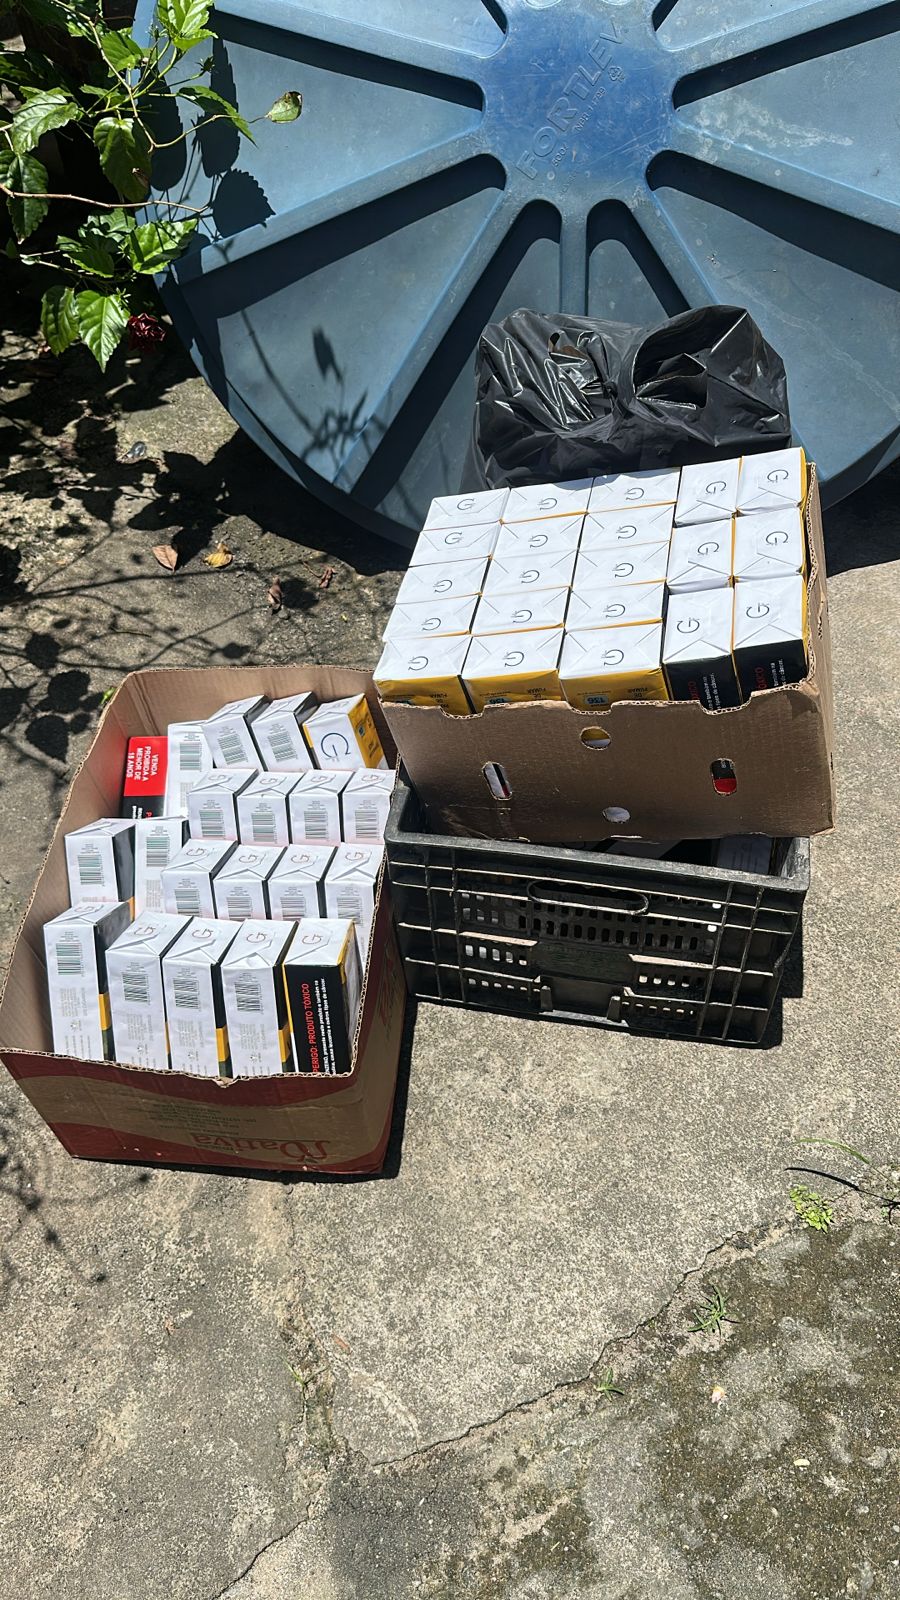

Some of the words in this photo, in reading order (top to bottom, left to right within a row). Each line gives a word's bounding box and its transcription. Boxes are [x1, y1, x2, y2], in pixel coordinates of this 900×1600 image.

[516, 15, 623, 180] FORTLEV
[126, 759, 135, 778] ANOS
[135, 747, 143, 770] MENOR
[143, 745, 152, 776] PROIBIDA
[151, 753, 159, 776] VENDA
[305, 1010, 317, 1044] PRODUTO
